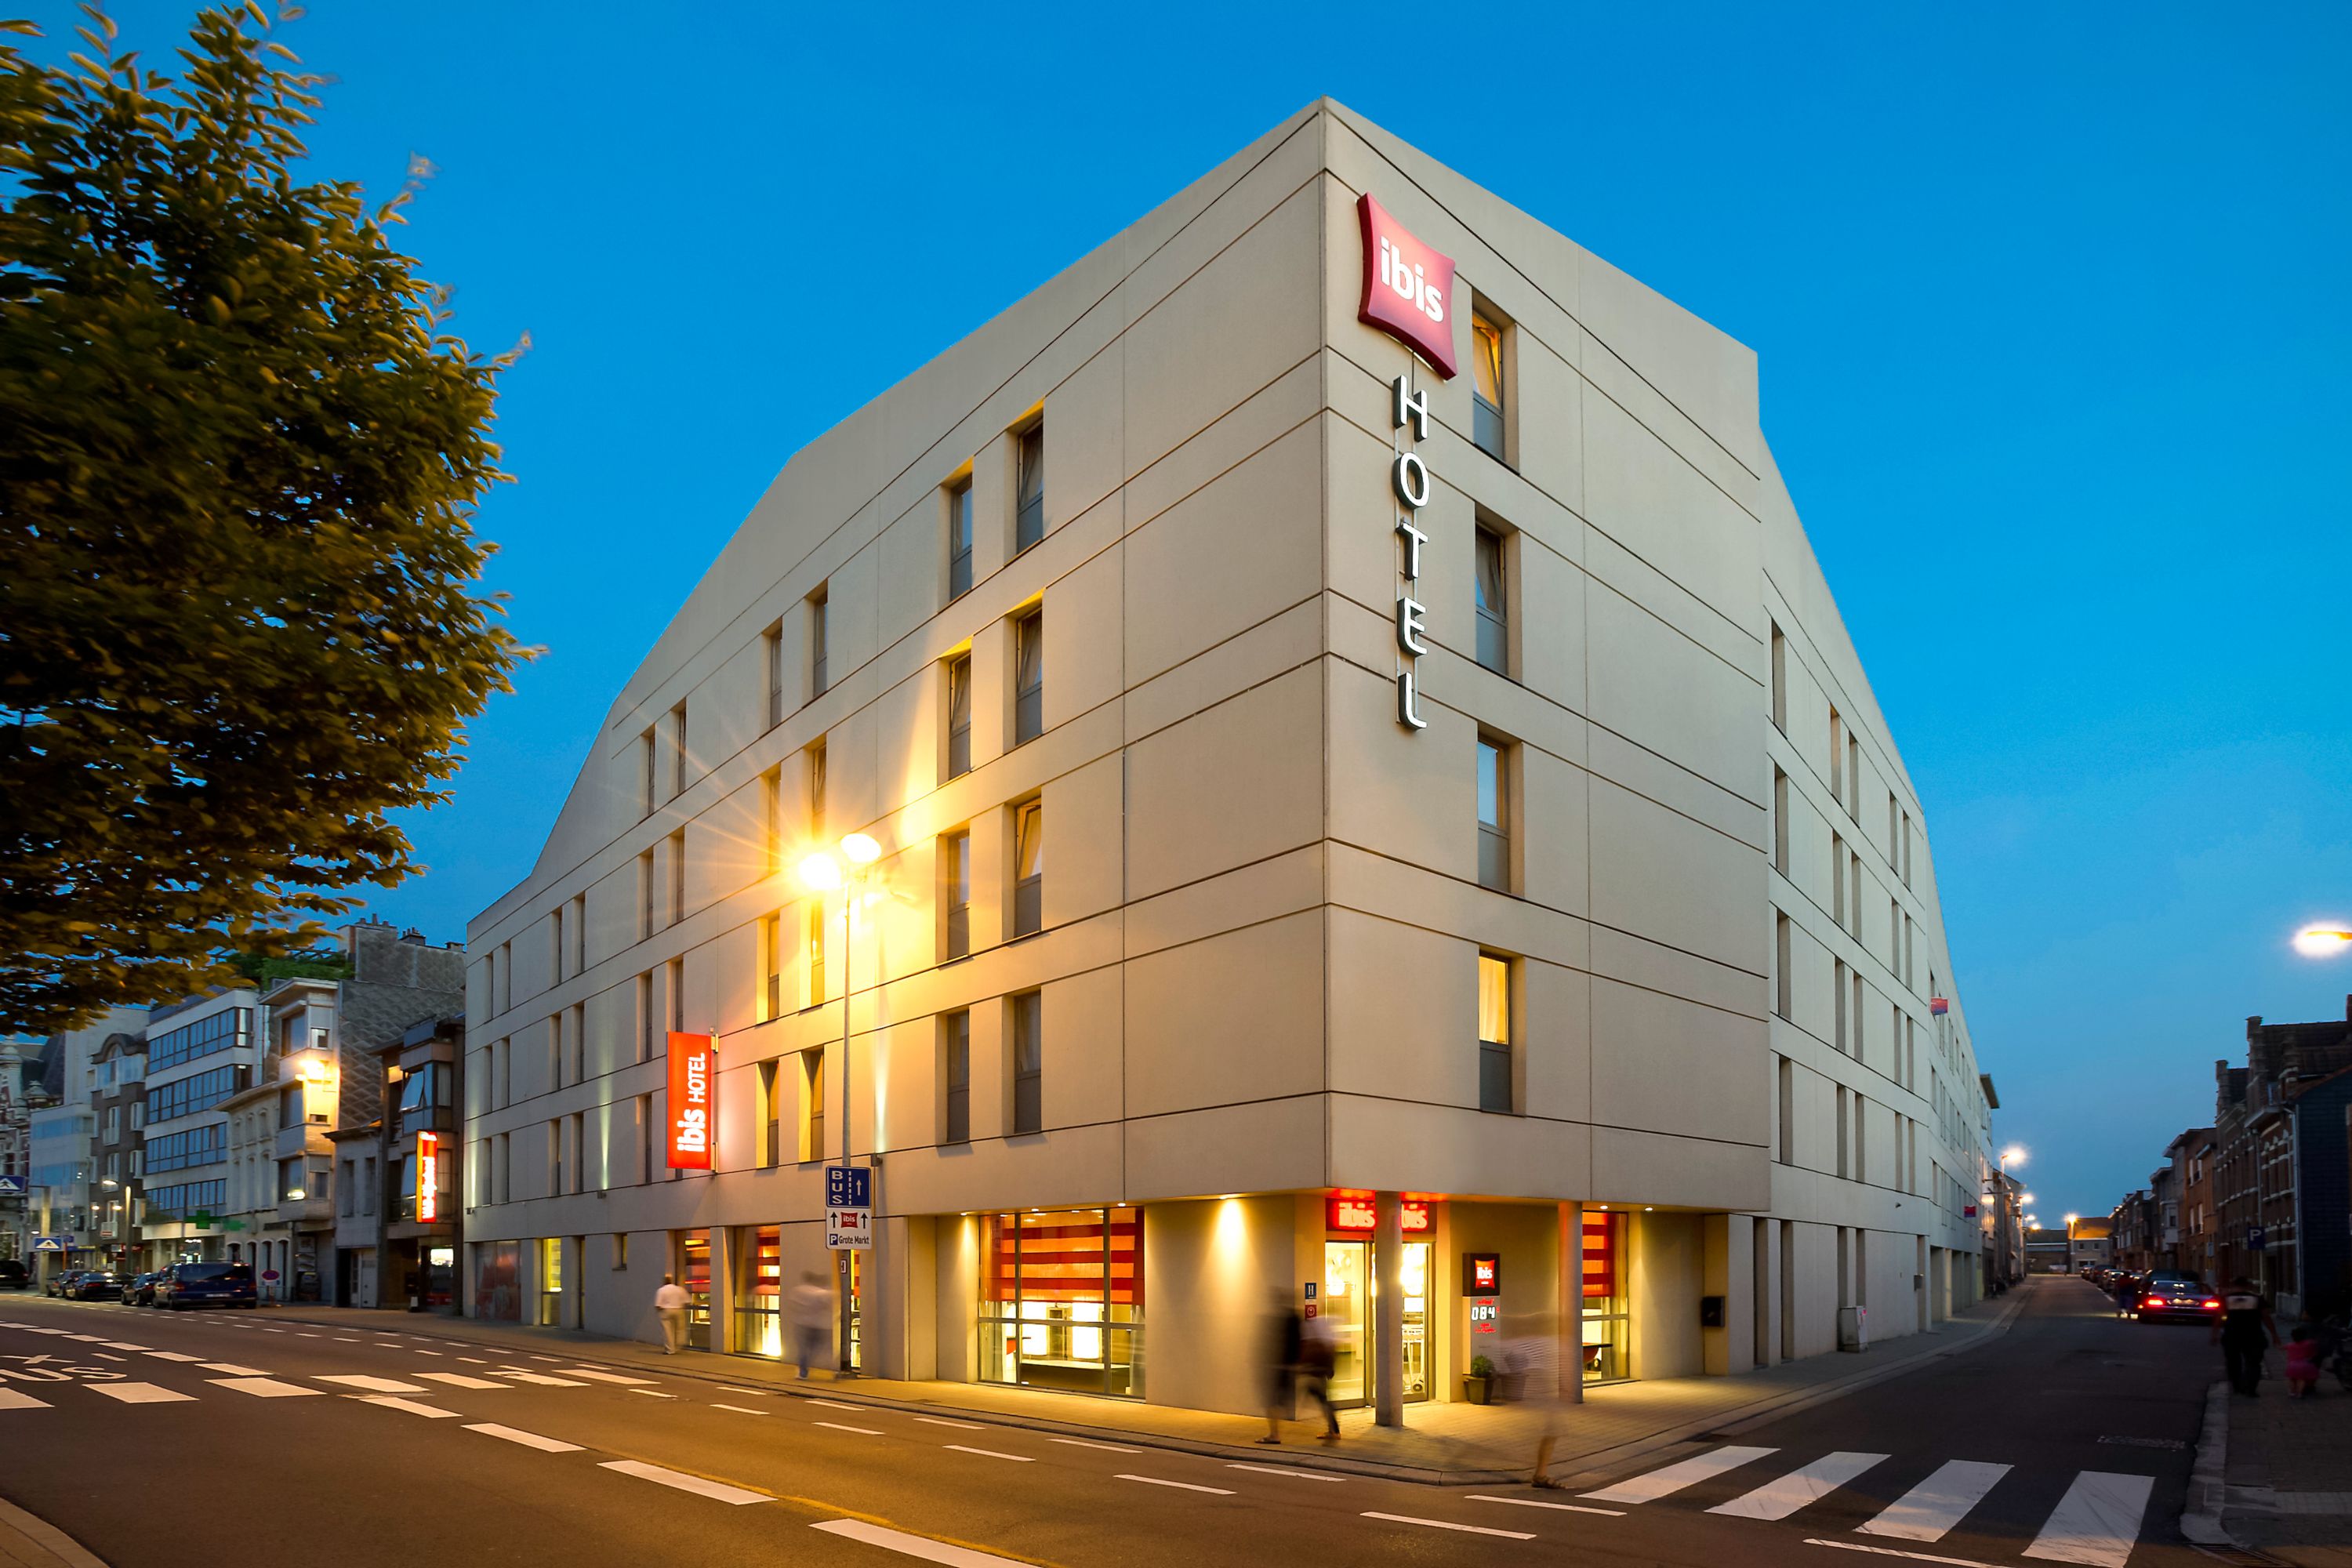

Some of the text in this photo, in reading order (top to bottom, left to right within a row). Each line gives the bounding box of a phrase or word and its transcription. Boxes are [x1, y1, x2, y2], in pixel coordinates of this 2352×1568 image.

[1380, 234, 1444, 323] ibis
[1392, 375, 1429, 730] HOTEL
[677, 1052, 706, 1152] ibis HOTEL
[831, 1171, 844, 1204] BUS
[1338, 1201, 1376, 1229] ibis
[1401, 1203, 1428, 1229] bis
[839, 1236, 854, 1244] Grote
[855, 1236, 869, 1244] Markt
[2249, 1229, 2262, 1241] P
[1476, 1266, 1493, 1279] ibis
[0, 1367, 128, 1382] US
